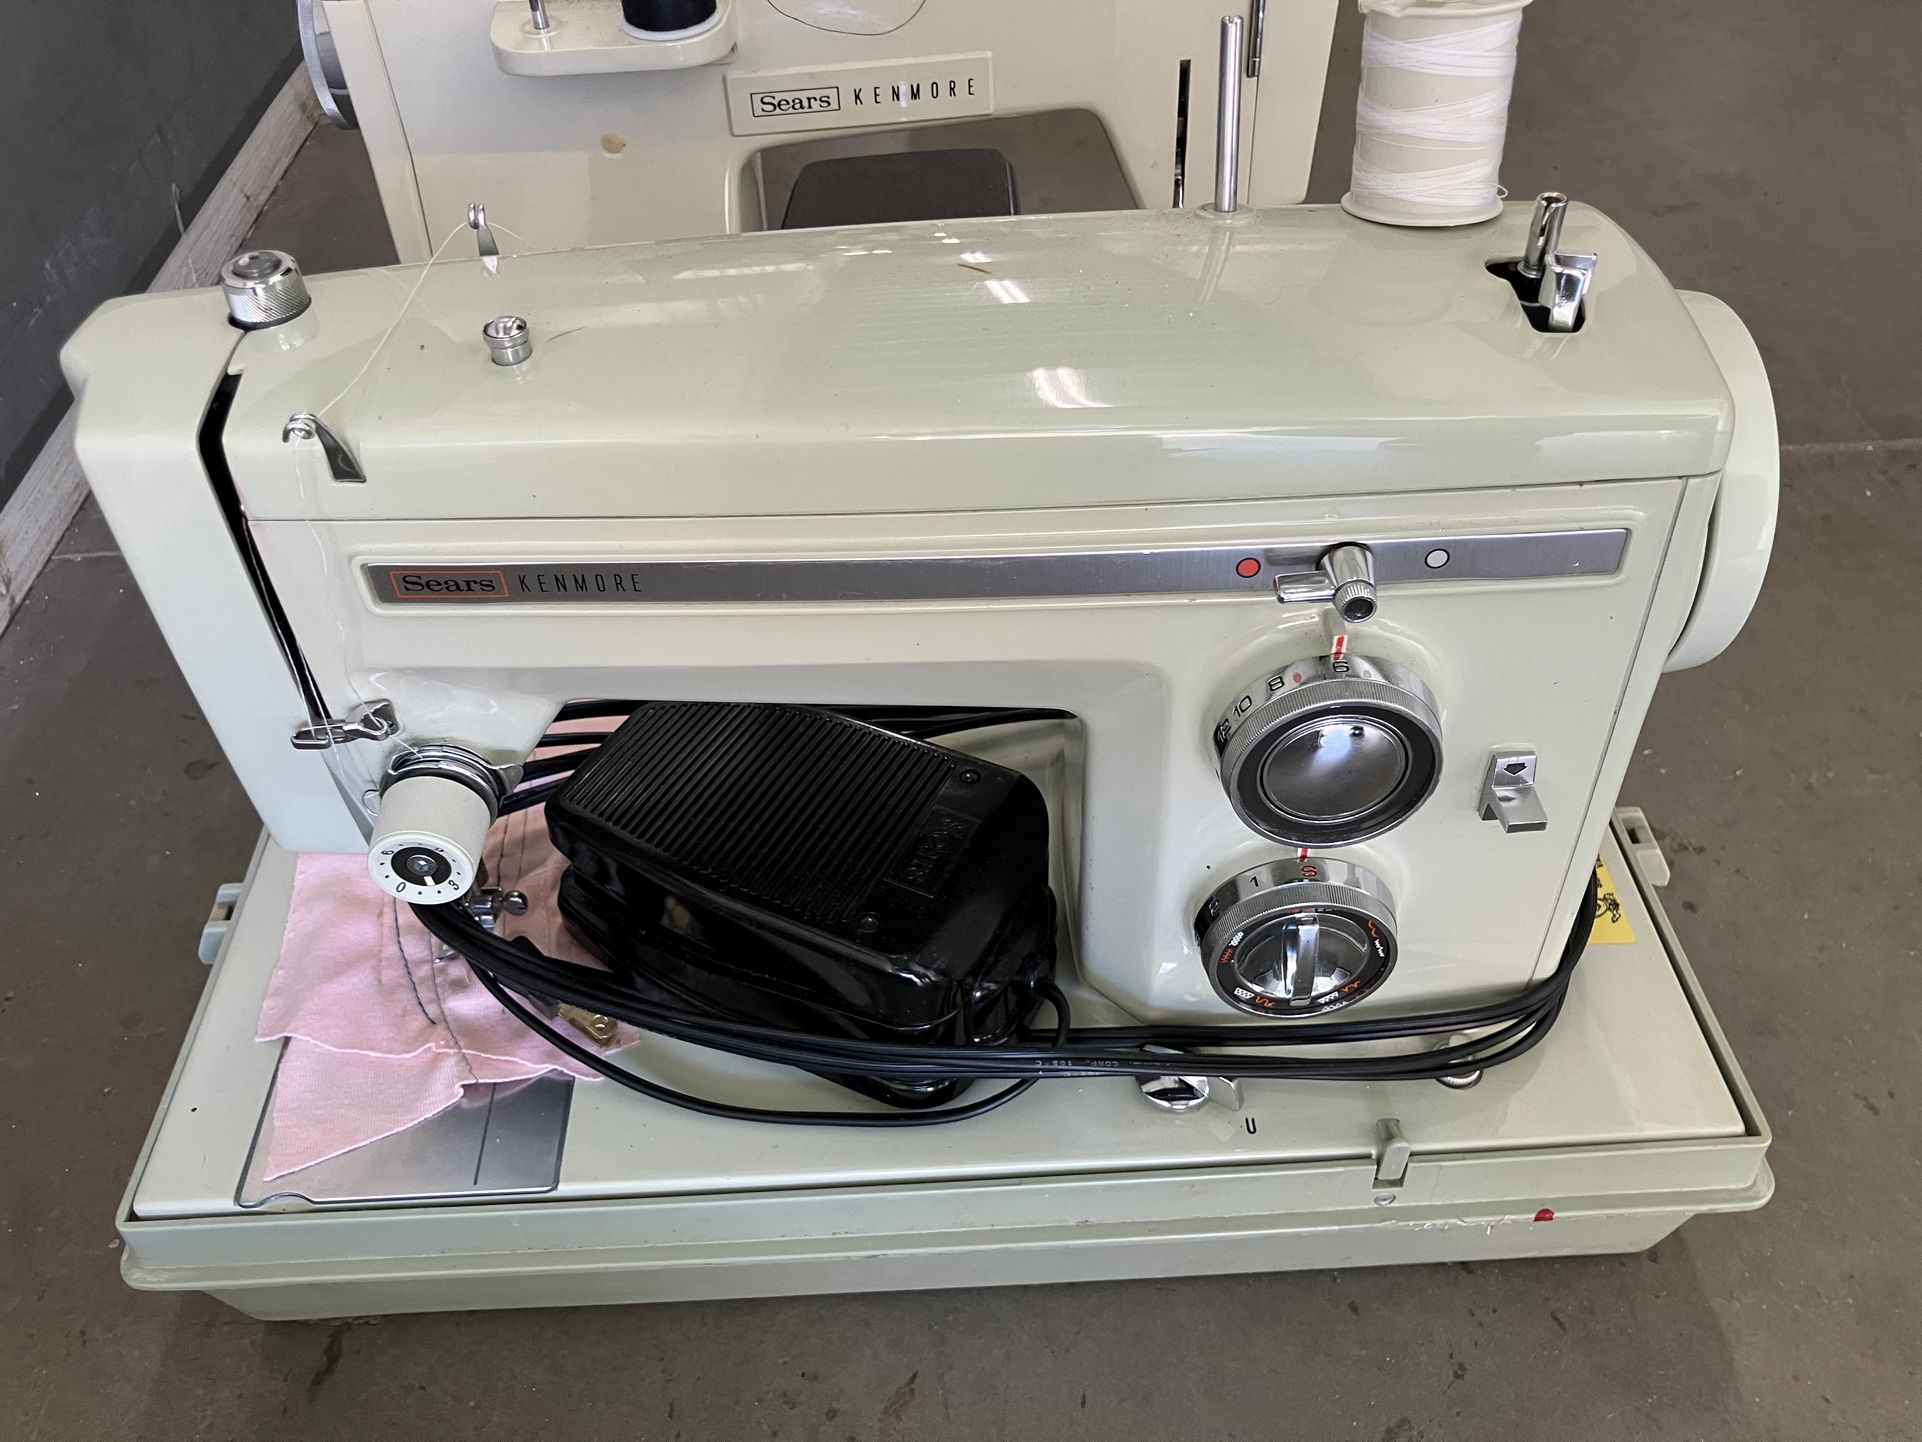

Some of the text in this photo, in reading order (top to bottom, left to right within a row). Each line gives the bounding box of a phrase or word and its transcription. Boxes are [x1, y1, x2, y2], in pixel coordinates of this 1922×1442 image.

[759, 78, 976, 114] Sears KENMORE
[401, 573, 643, 593] Sears KENMORE
[1232, 695, 1253, 718] 10
[1268, 676, 1285, 692] 8
[1332, 659, 1350, 673] 6
[448, 879, 460, 891] 3
[1249, 875, 1259, 888] 1
[1301, 864, 1318, 878] S
[395, 881, 407, 893] 0
[1245, 1116, 1257, 1135] U
